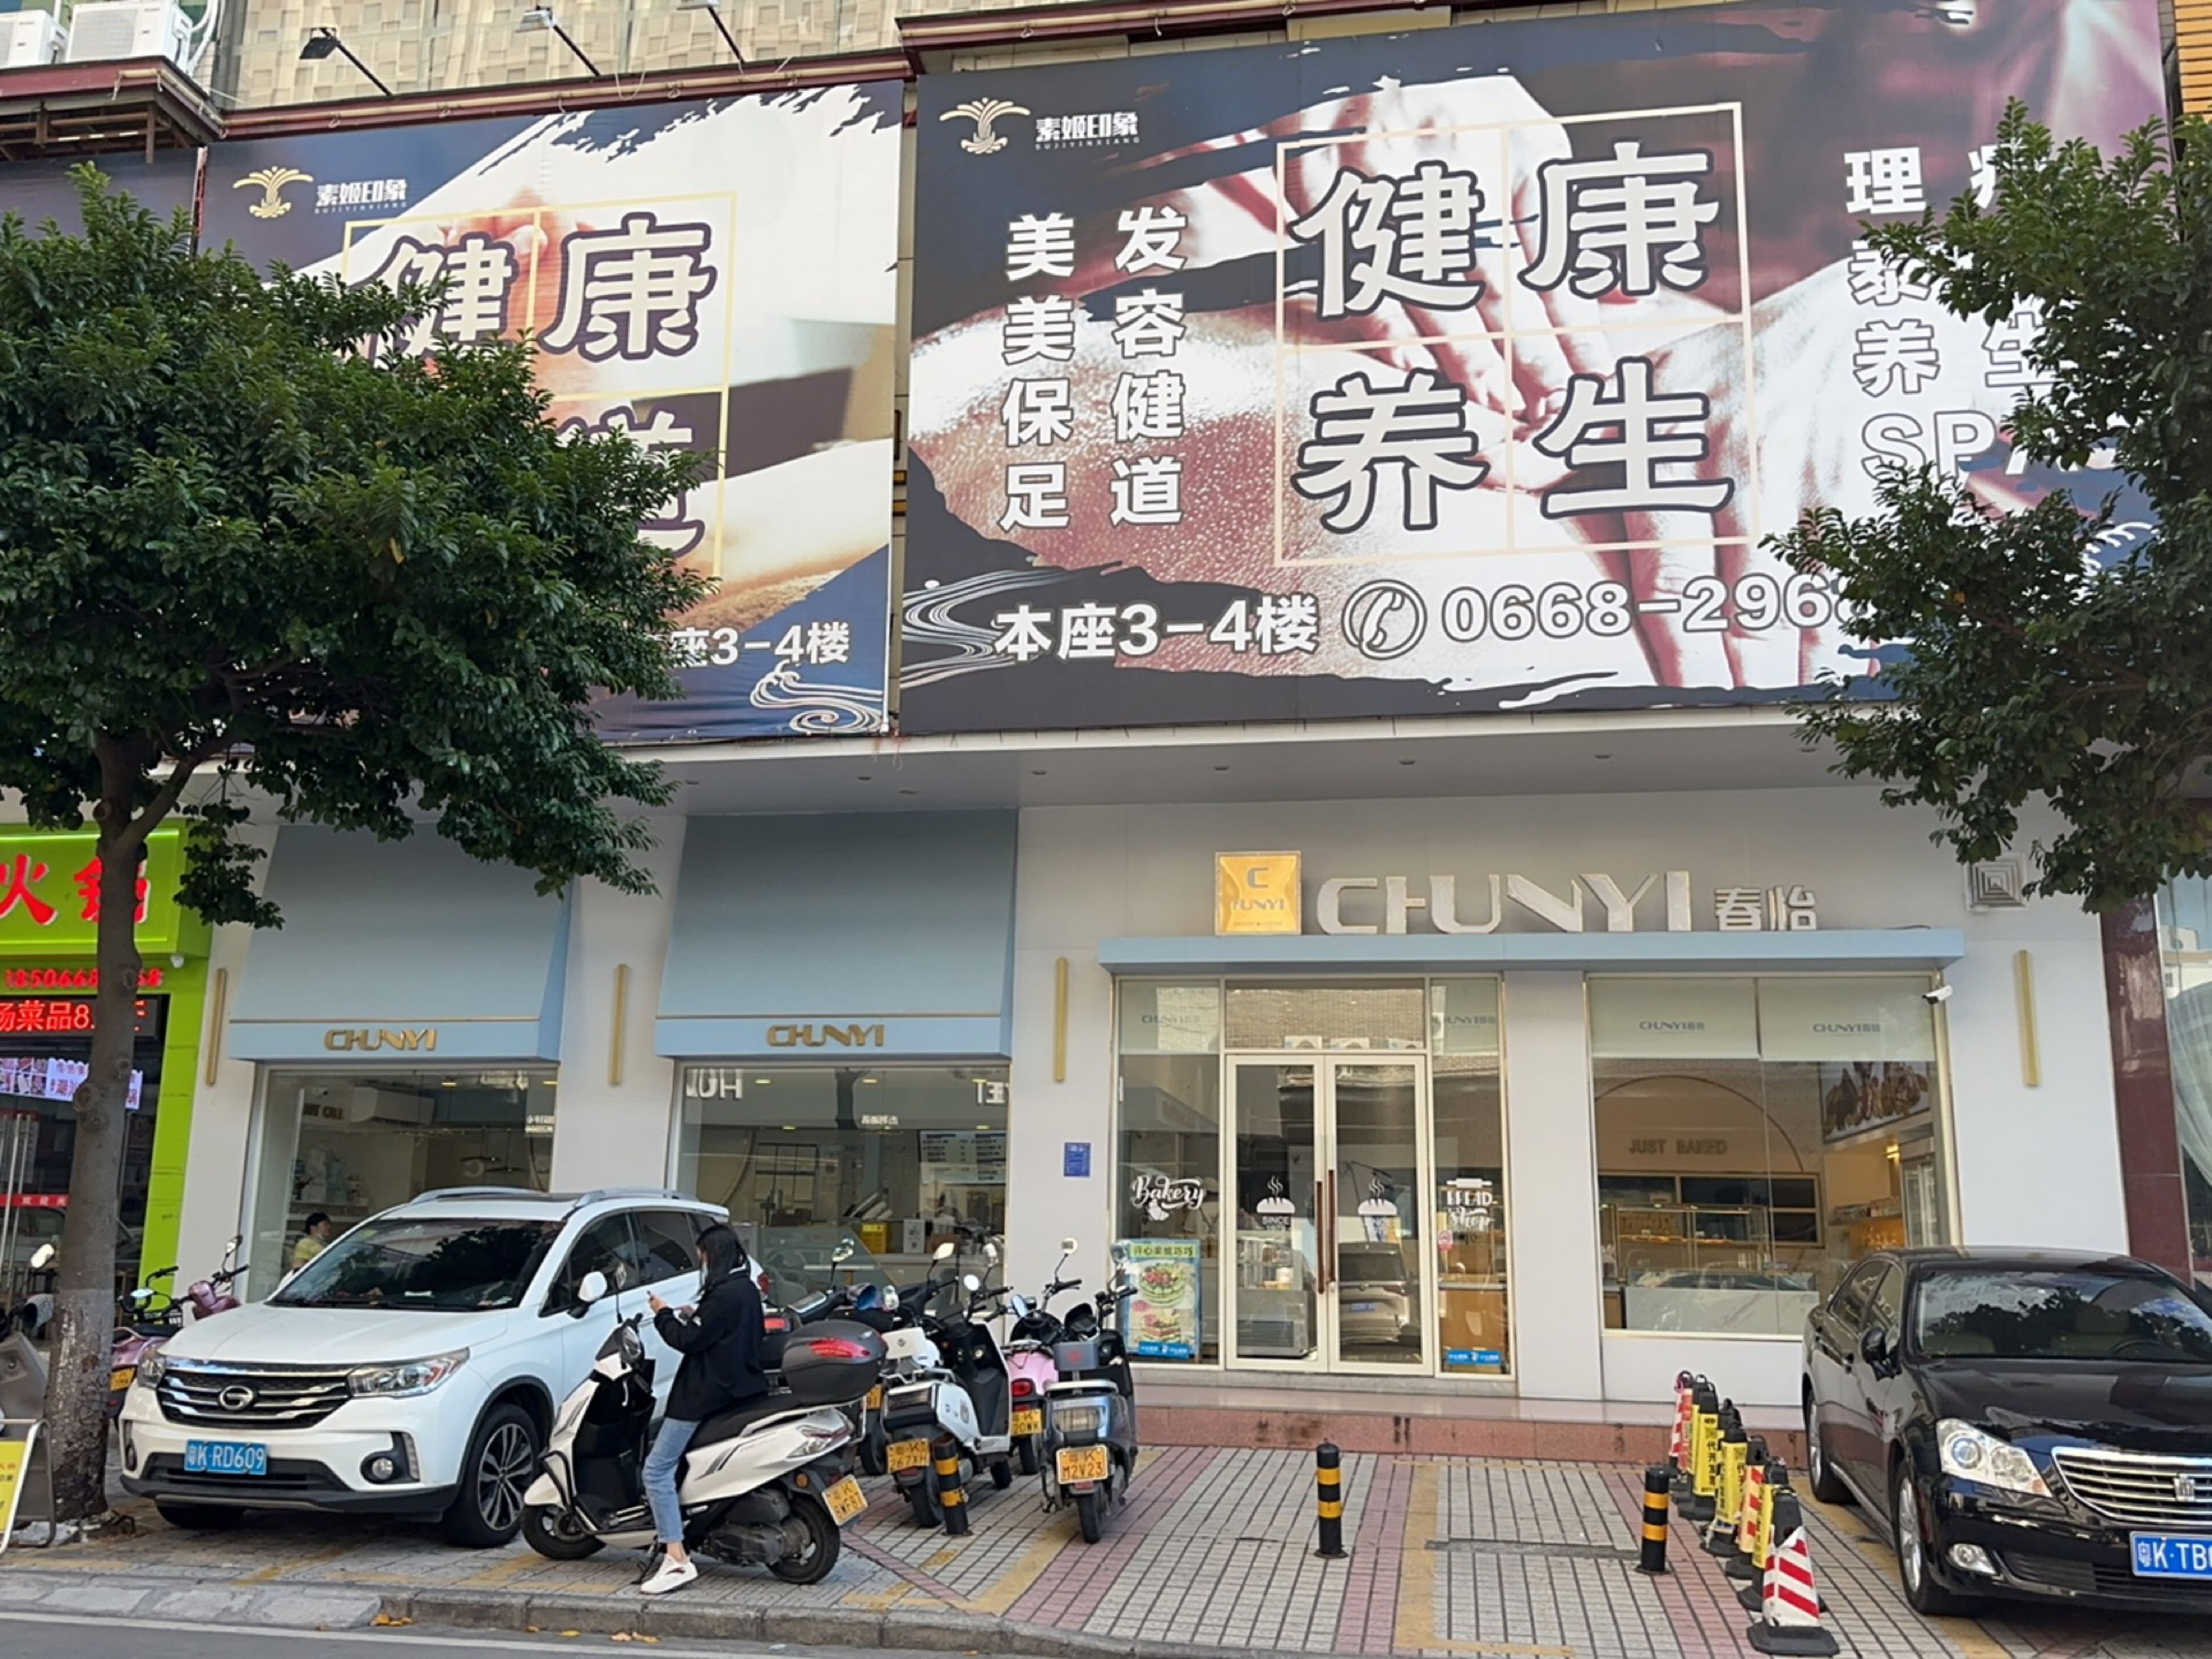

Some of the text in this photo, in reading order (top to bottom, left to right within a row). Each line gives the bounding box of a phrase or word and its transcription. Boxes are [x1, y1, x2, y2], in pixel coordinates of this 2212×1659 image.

[1036, 111, 1138, 143] 素姬印象
[316, 179, 407, 207] 素姬印象
[1006, 206, 1187, 282] 美发
[1288, 140, 1722, 319] 健康
[1001, 288, 1186, 365] 美容
[1000, 369, 1185, 448] 保健
[1289, 356, 1735, 534] 养生
[997, 455, 1184, 533] 足道
[659, 621, 851, 668] 座3-4楼
[1317, 870, 1819, 936] CHUNYI 春怡
[324, 1029, 437, 1050] CHUNYI
[766, 1024, 885, 1046] CHUNYI
[1629, 1139, 1727, 1155] JUST BAKED
[1131, 1175, 1204, 1209] Bakery
[2138, 1541, 2212, 1571] 粤K·TB
